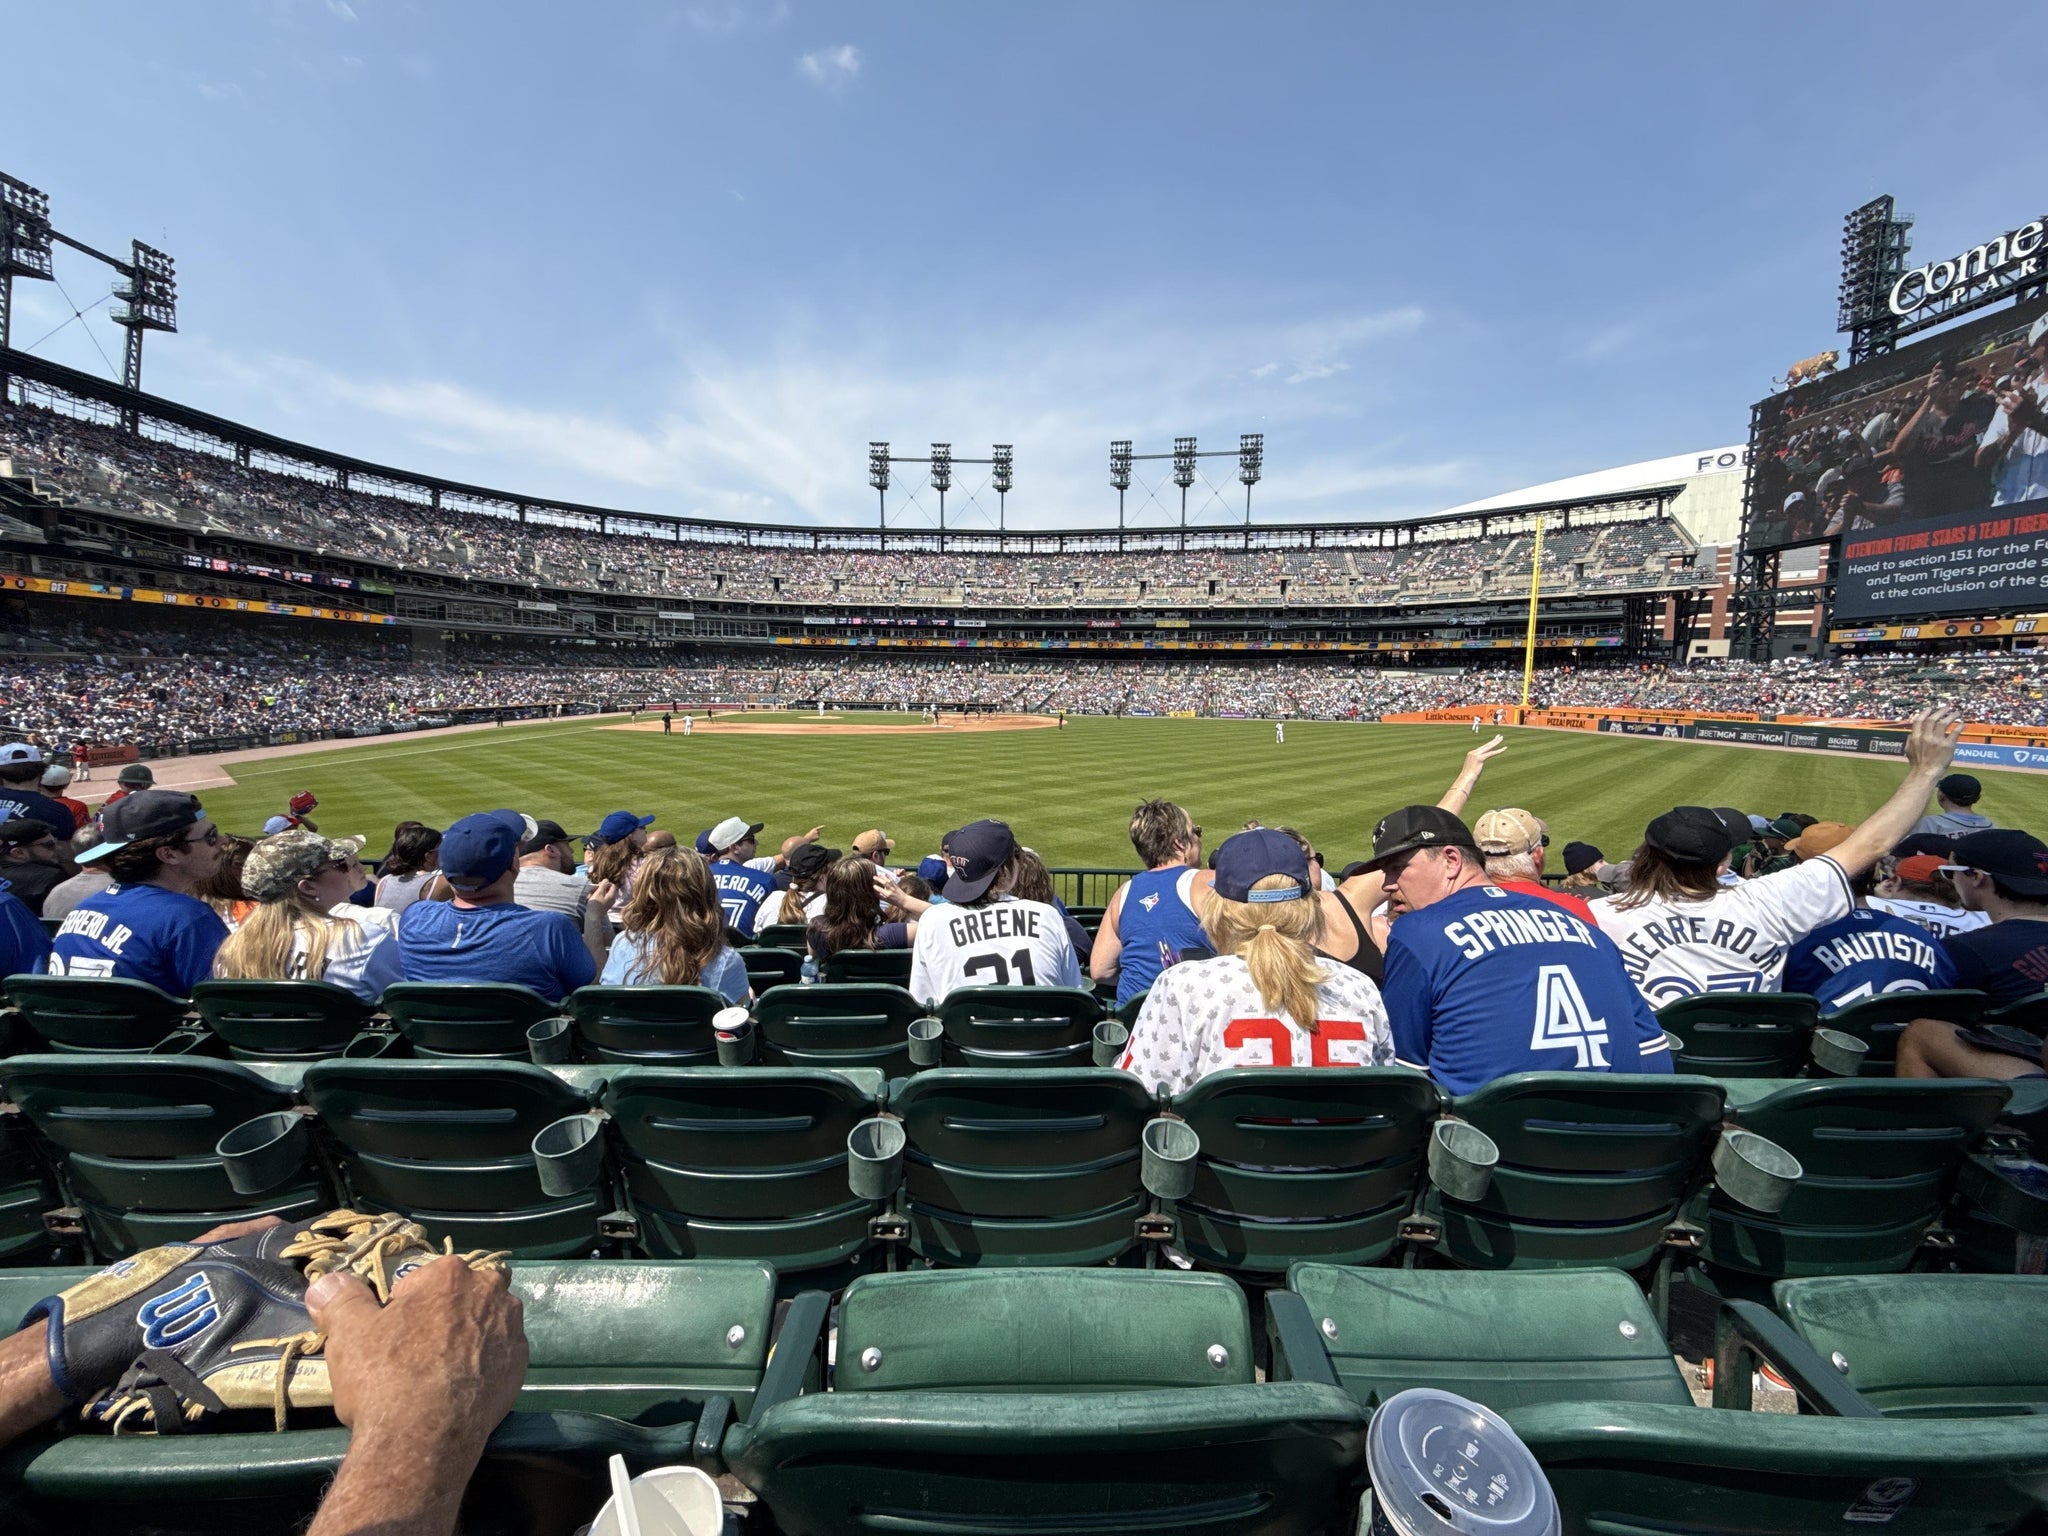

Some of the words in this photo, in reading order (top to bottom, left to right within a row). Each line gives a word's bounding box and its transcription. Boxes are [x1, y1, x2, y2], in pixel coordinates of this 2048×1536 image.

[1889, 217, 2048, 315] Come
[1845, 538, 1893, 559] ATTENTION
[1893, 532, 1931, 552] FUTURE
[1931, 526, 1966, 547] STARS
[1979, 519, 2011, 539] TEAM
[1848, 561, 1880, 575] Head
[1882, 560, 1896, 571] to
[1898, 554, 1946, 568] section
[1949, 550, 1973, 562] 151
[1976, 546, 1999, 559] for
[2003, 543, 2030, 555] the
[1866, 575, 1890, 587] and
[1893, 572, 1928, 584] Team
[1931, 566, 1975, 582] Tigers
[1978, 557, 2037, 577] parade
[51, 582, 68, 593] DET
[1871, 590, 1885, 600] at
[1888, 587, 1909, 598] the
[1911, 580, 1985, 597] conclusion
[1989, 576, 2006, 589] of
[2008, 574, 2037, 587] the
[1901, 627, 1920, 638] TOR
[2014, 620, 2037, 632] DET
[1425, 712, 1443, 721] Little
[1444, 713, 1470, 721] Caesars
[1546, 717, 1565, 728] PIZZA!
[1566, 719, 1586, 729] PIZZA!
[269, 733, 297, 745] bet365
[1704, 730, 1736, 739] BETMGM
[1746, 732, 1784, 743] BETMGM
[1828, 737, 1859, 746] BIGGBY
[1954, 748, 2000, 759] FANDUEL
[101, 923, 133, 955] JR
[949, 908, 1041, 948] GREENE
[1444, 909, 1598, 960] SPRINGER
[1622, 916, 1757, 985] GUERRERO
[1750, 942, 1782, 979] JR.
[1812, 931, 1936, 975] BAUTISTA
[1530, 964, 1611, 1068] 4
